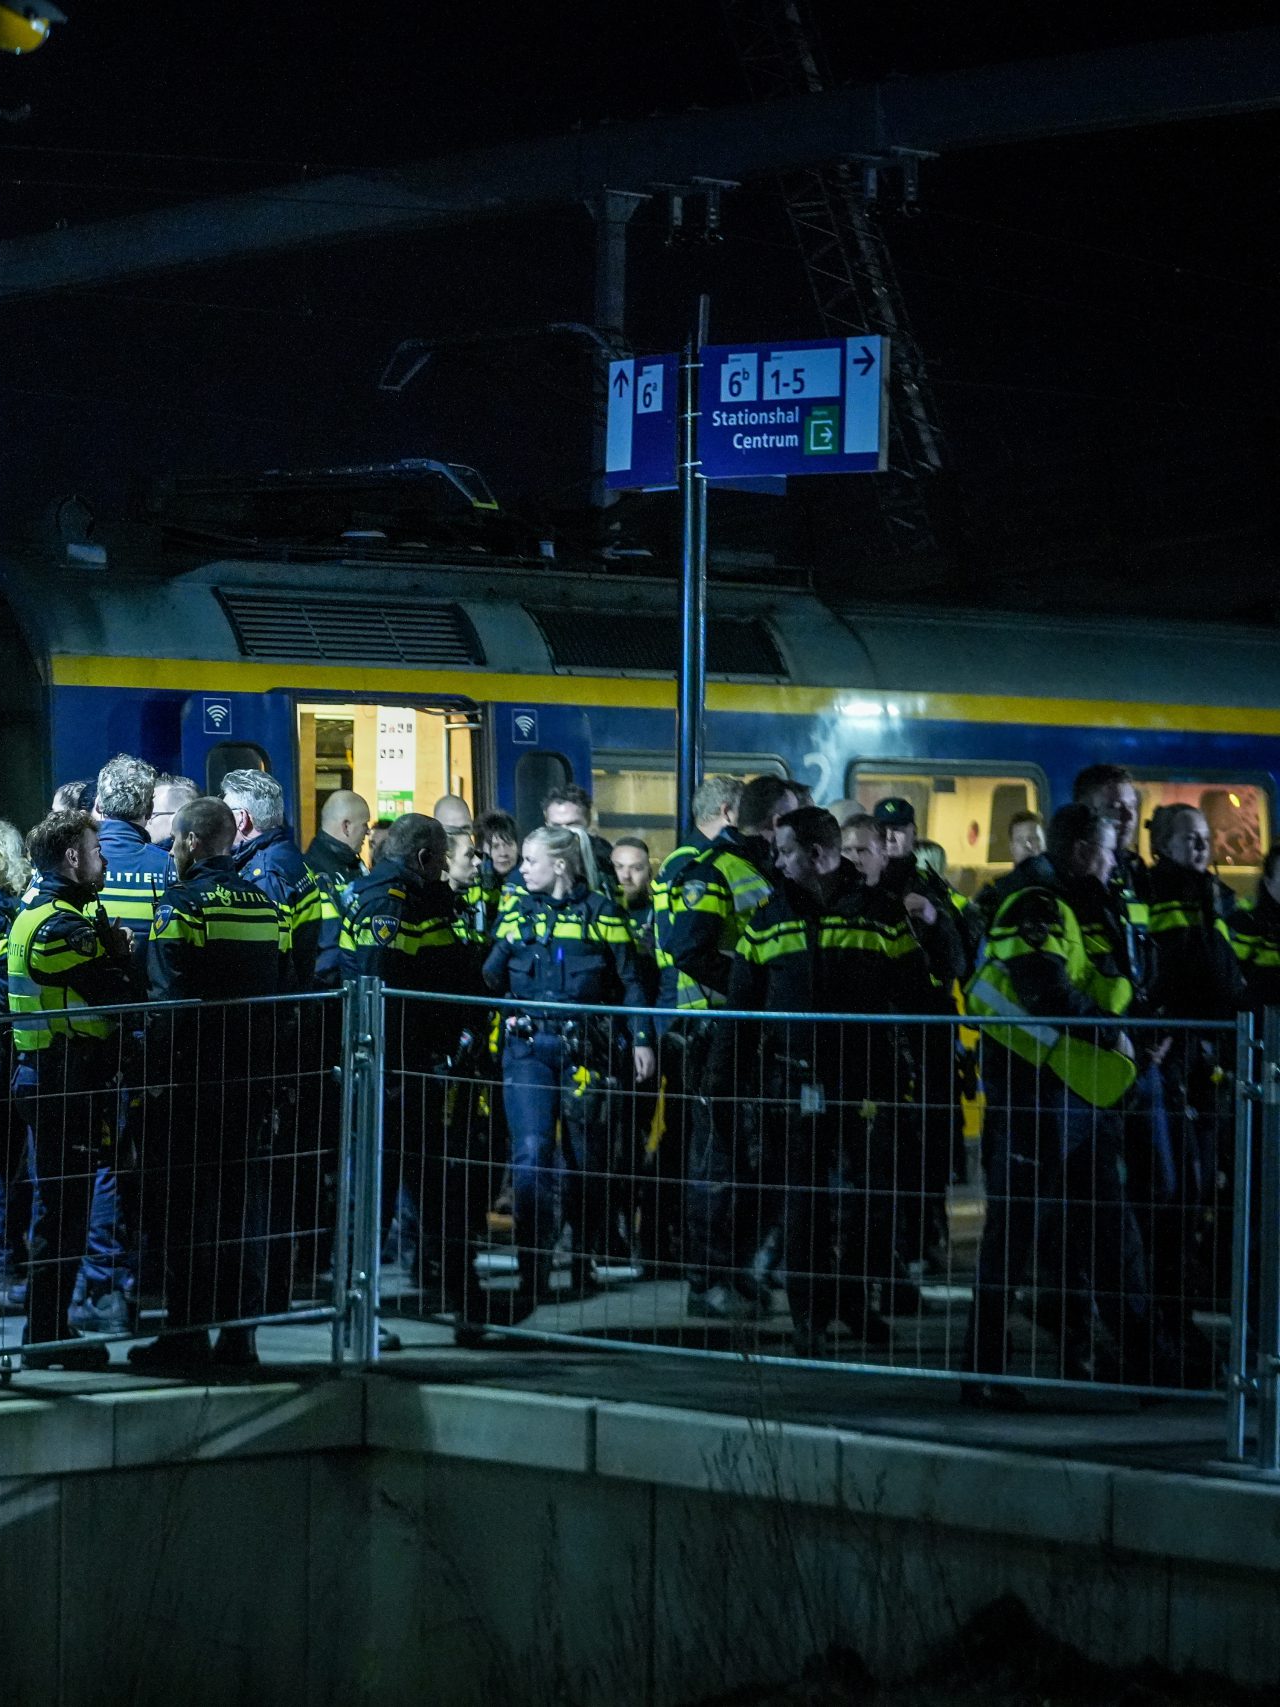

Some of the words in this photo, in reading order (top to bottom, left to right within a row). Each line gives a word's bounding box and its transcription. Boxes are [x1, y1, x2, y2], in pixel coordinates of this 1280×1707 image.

[771, 367, 806, 396] 1-5
[711, 405, 800, 427] Stationshal
[732, 432, 799, 450] Centrum
[105, 871, 153, 884] LITIE
